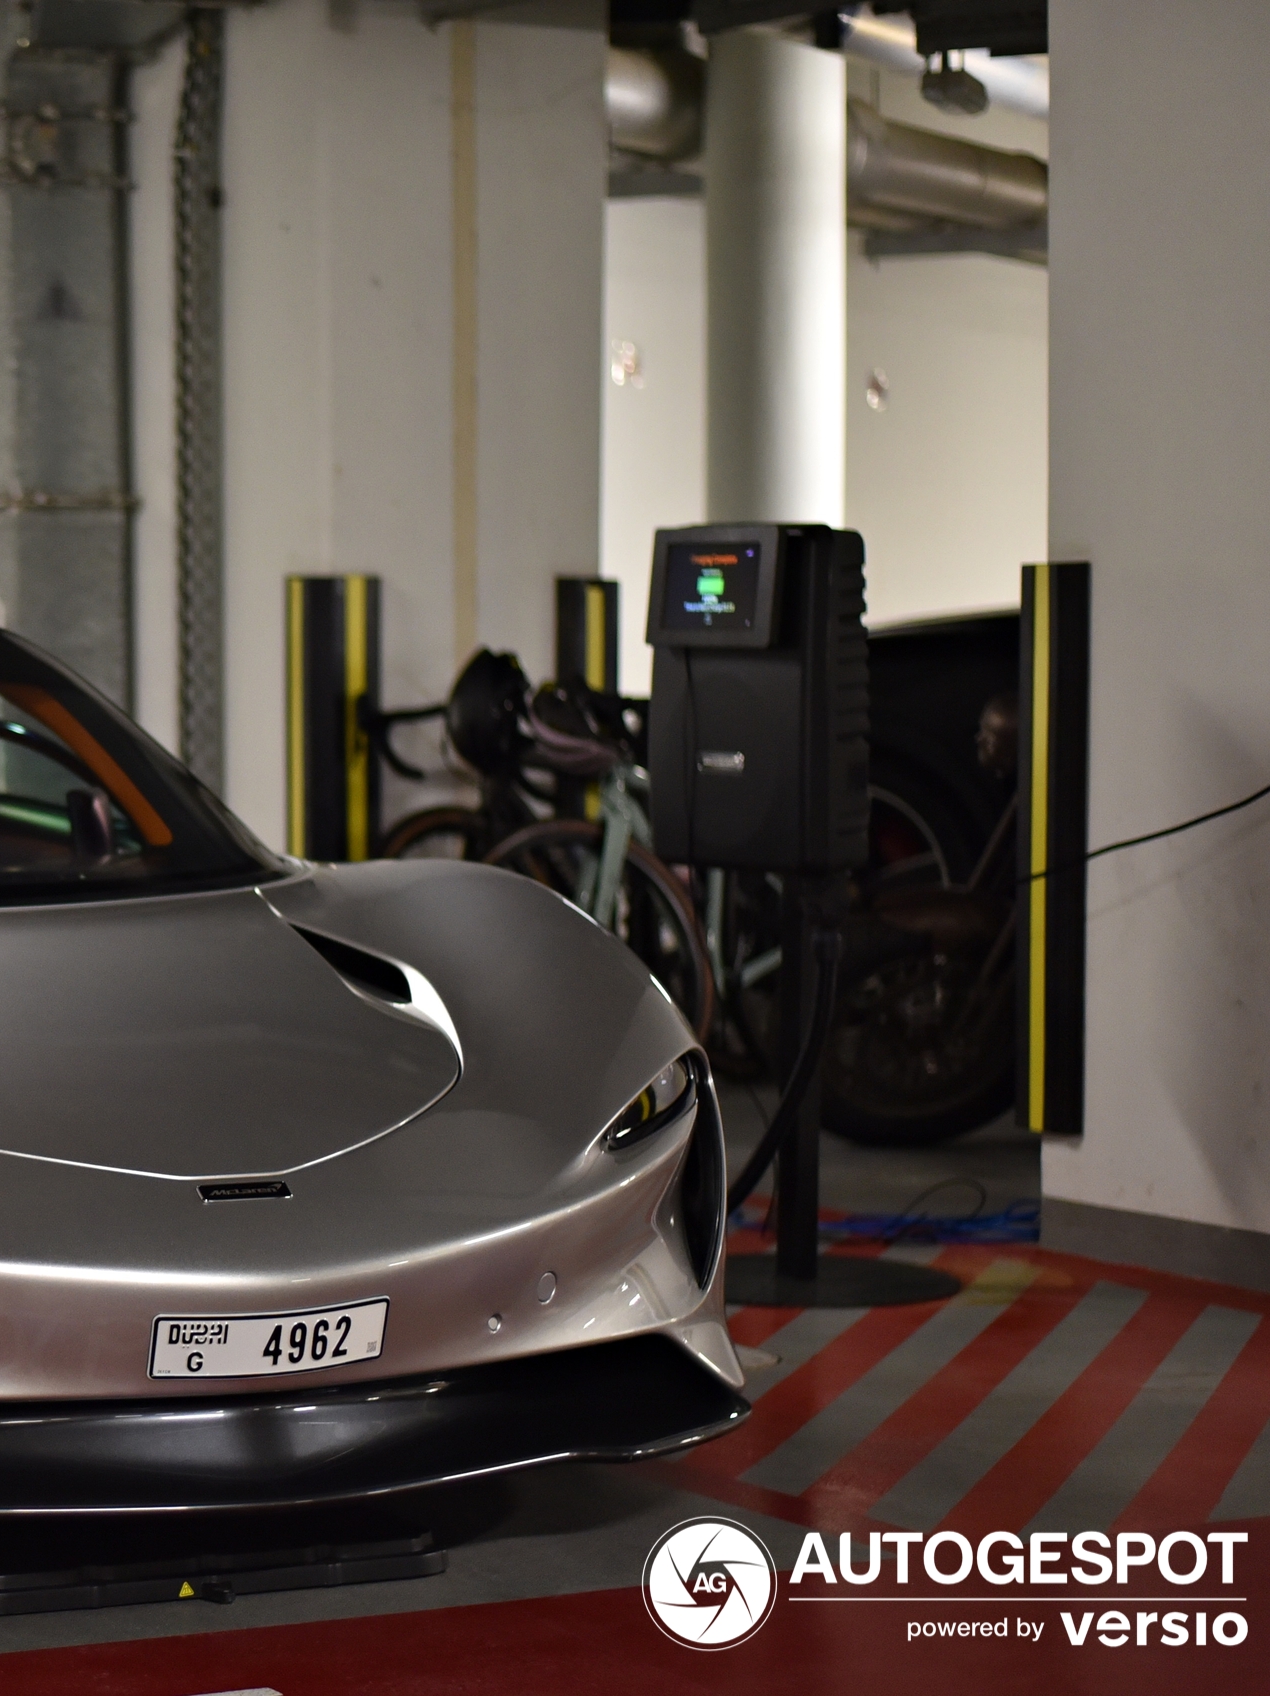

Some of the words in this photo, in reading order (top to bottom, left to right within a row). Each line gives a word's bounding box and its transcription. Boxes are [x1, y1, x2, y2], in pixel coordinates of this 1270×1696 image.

[210, 1186, 278, 1196] McLaren
[168, 1323, 229, 1345] DUBAI
[263, 1315, 352, 1366] 4962
[187, 1352, 204, 1372] G
